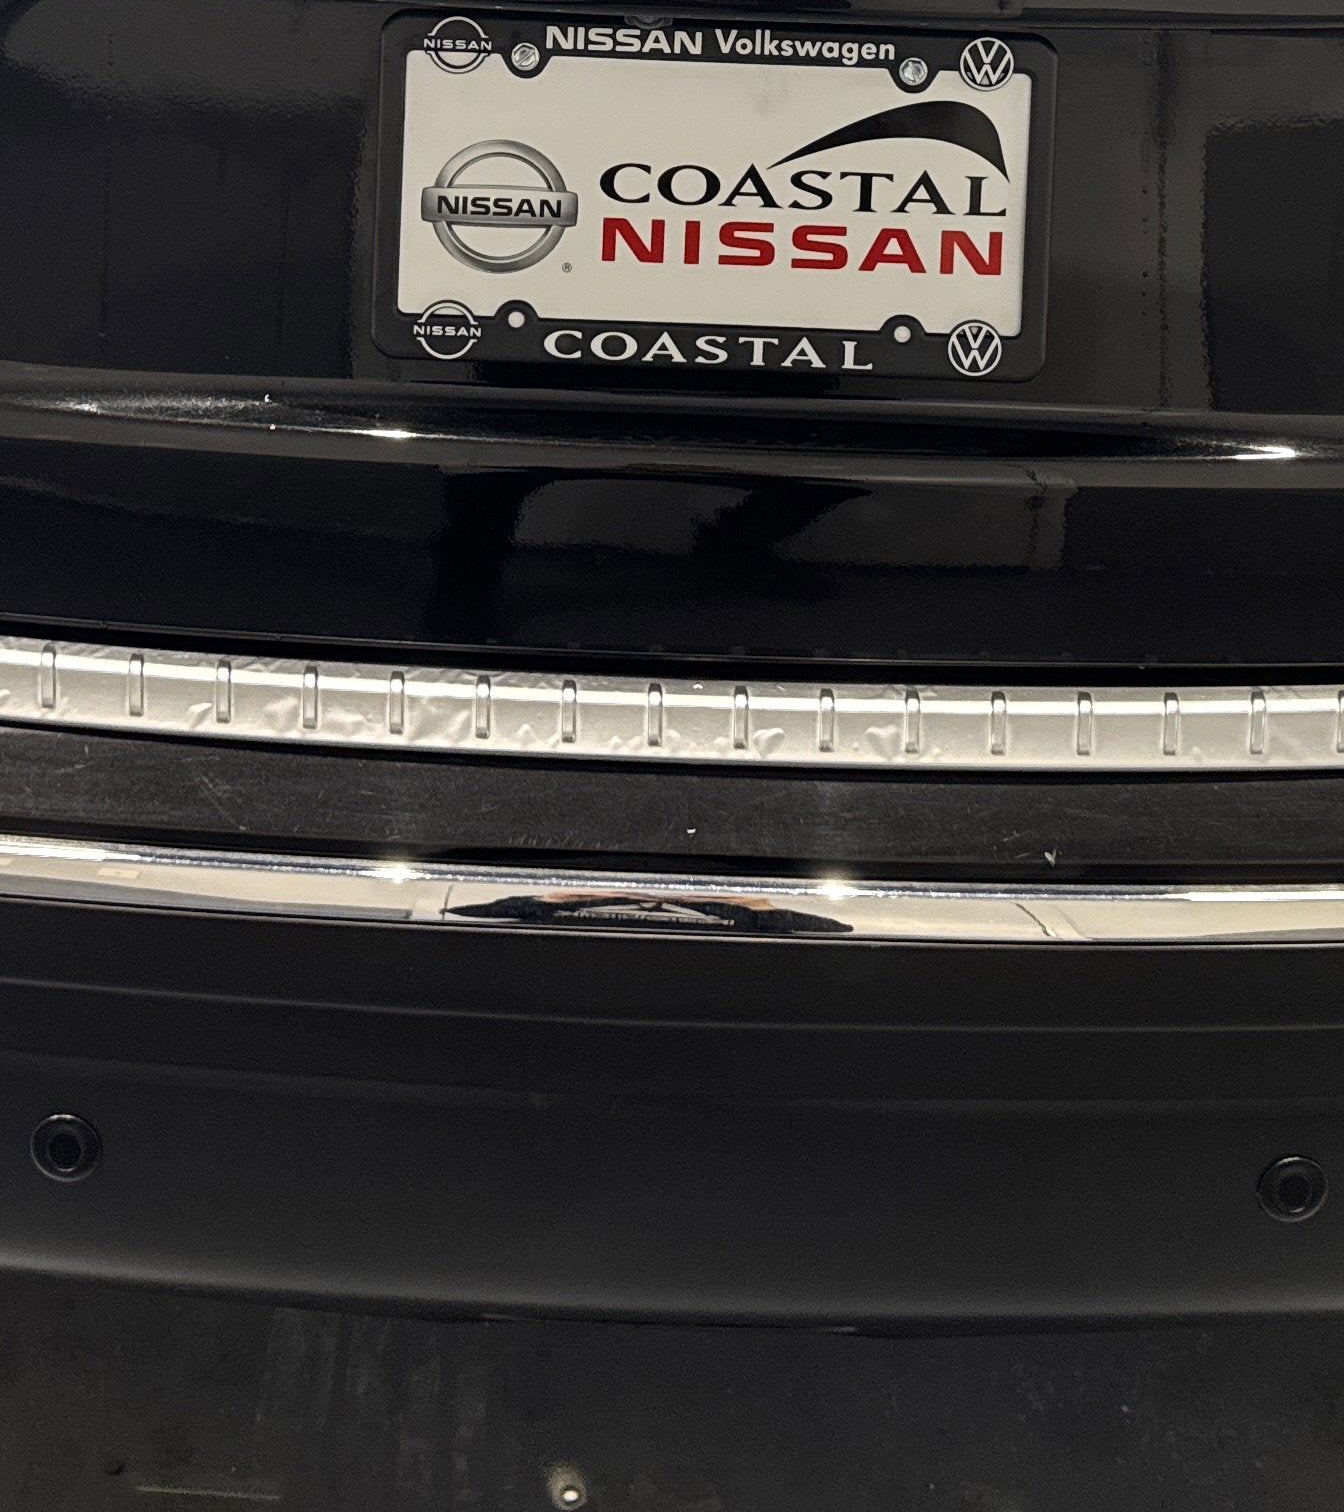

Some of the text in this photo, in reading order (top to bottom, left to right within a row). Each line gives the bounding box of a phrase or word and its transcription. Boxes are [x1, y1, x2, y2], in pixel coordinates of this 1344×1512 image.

[423, 38, 492, 50] NISSAN
[545, 25, 896, 65] NISSAN Volkswagen
[437, 195, 562, 218] NISSAN
[599, 162, 1008, 217] COASTAL
[601, 217, 1004, 276] NISSAN
[413, 324, 482, 337] NISSAN
[543, 330, 873, 369] COASTAL
